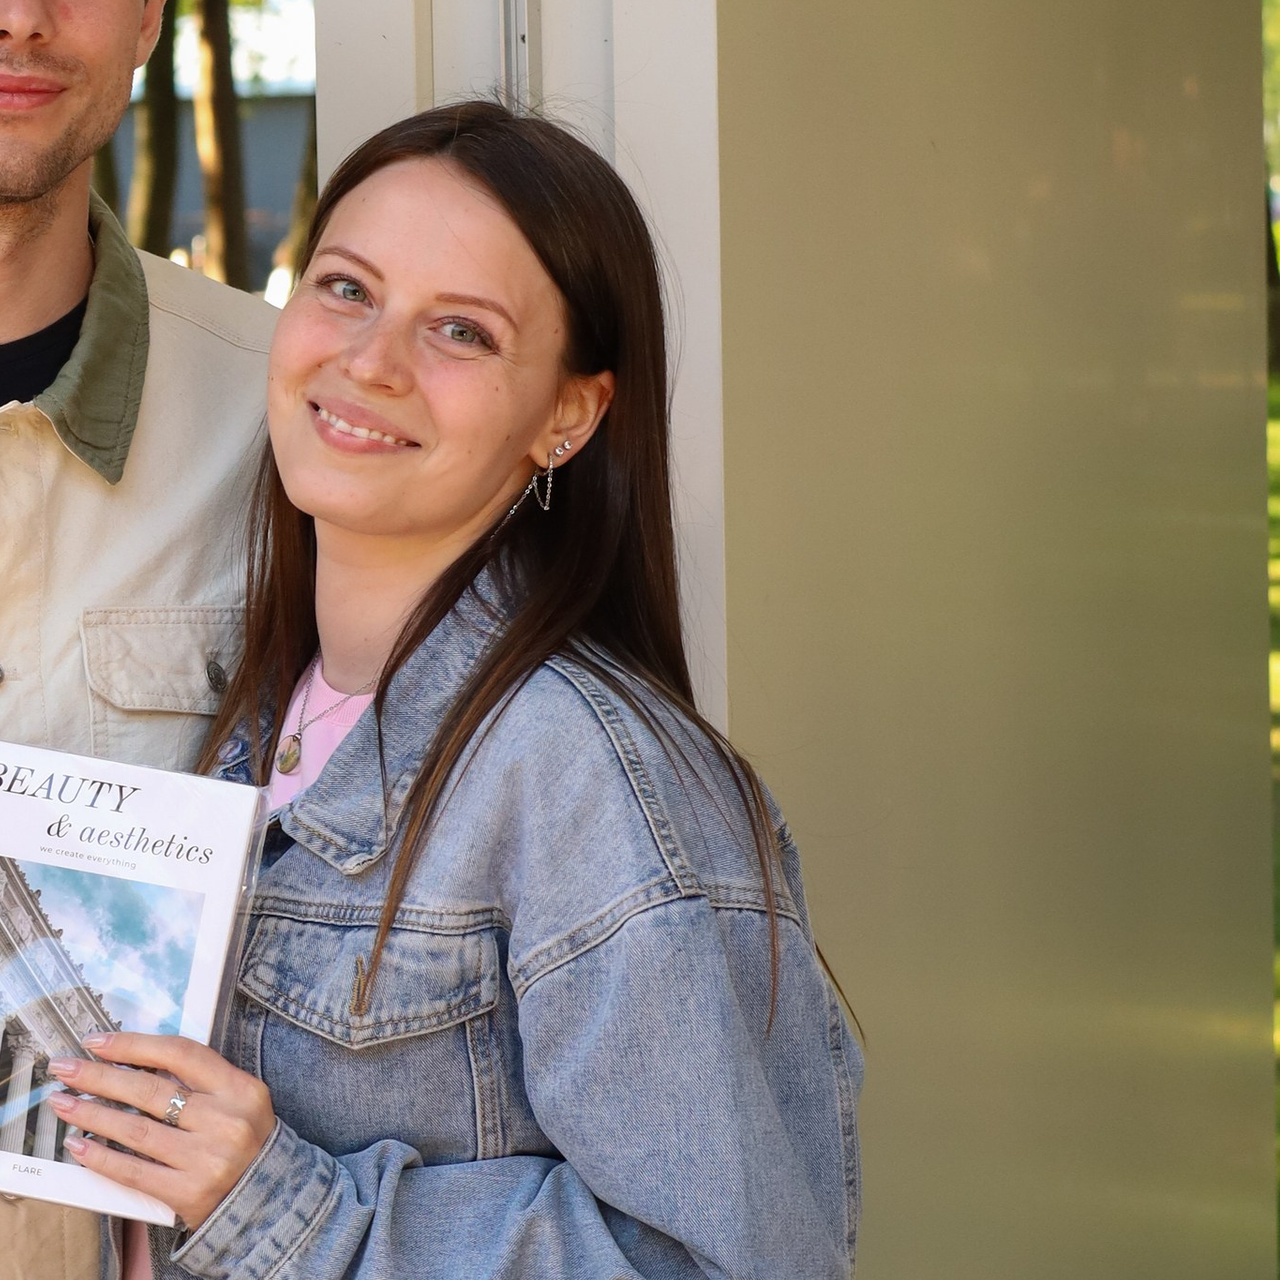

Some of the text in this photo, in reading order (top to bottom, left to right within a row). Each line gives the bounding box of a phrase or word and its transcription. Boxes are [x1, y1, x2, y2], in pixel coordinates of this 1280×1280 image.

[46, 813, 215, 865] & aesthetics
[39, 845, 137, 870] we create everything
[12, 1163, 43, 1176] FLARE
